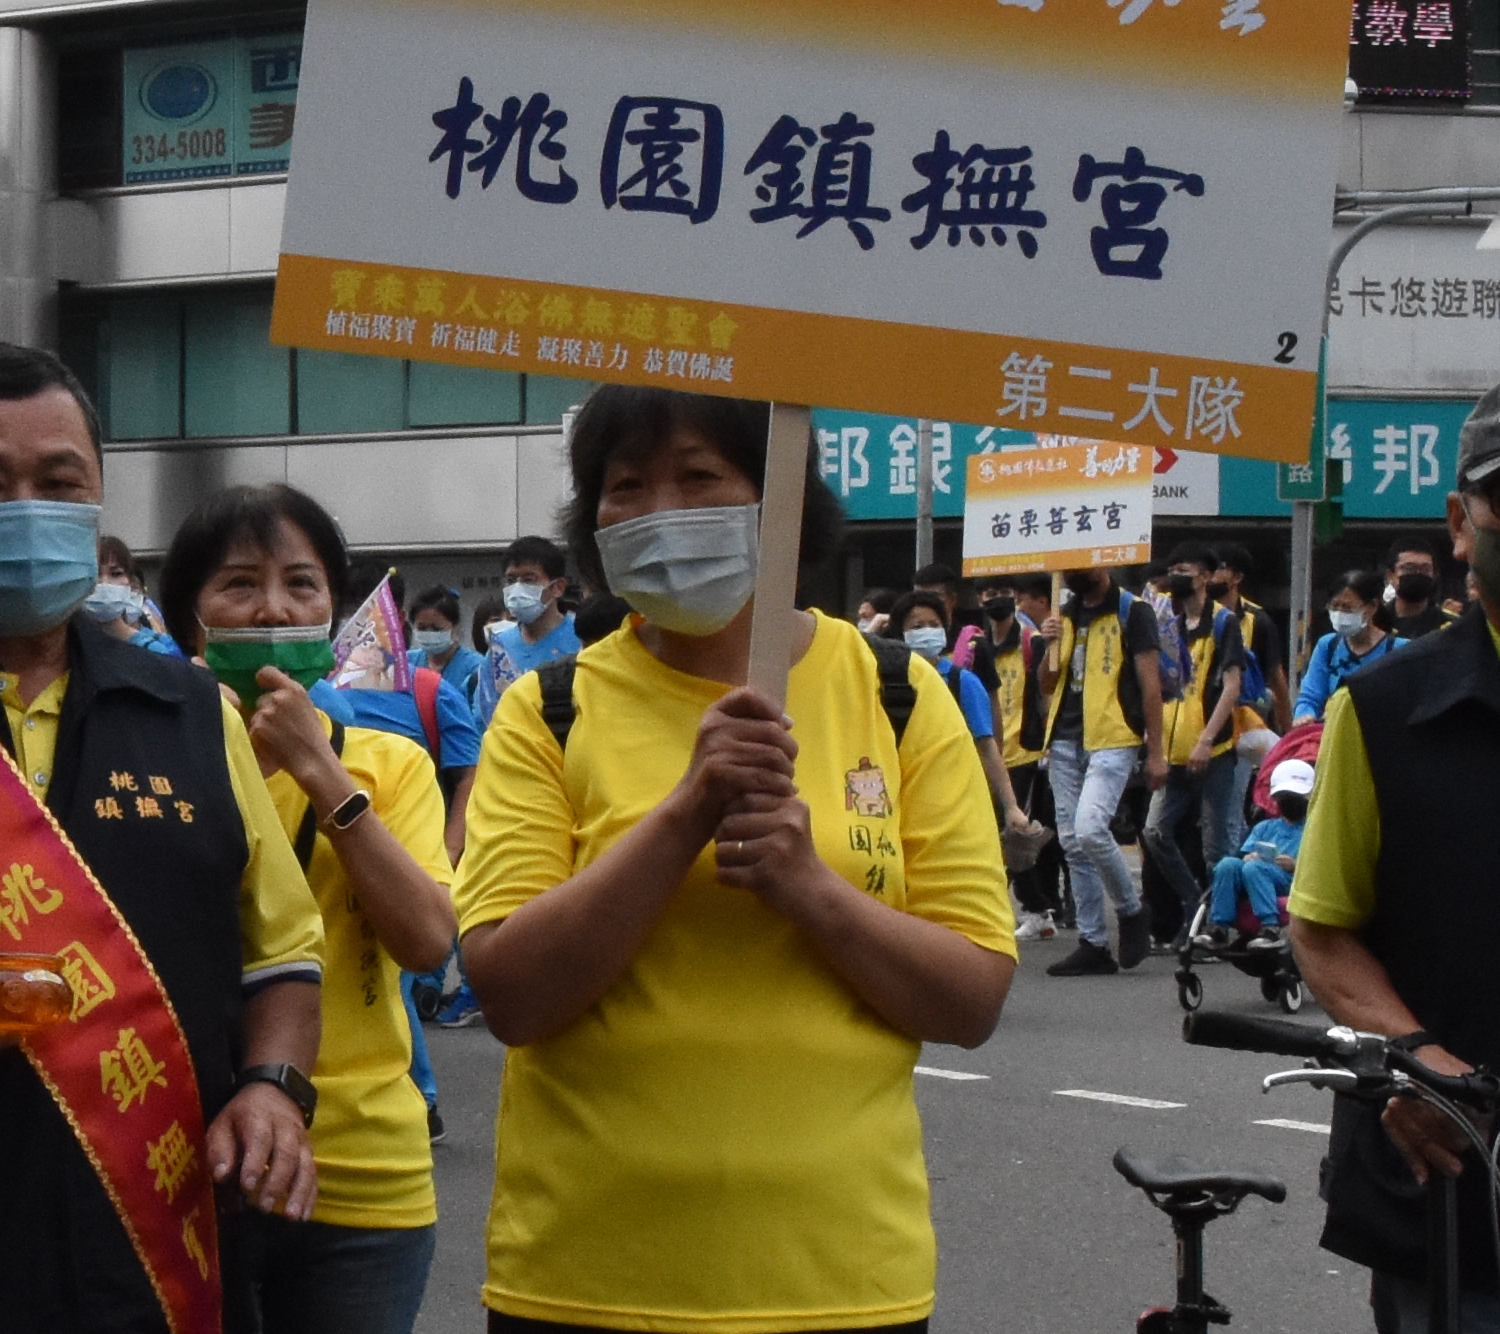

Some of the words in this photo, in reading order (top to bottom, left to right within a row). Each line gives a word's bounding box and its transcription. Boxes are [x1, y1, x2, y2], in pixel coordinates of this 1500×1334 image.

[428, 76, 1205, 282] 桃園鎮撫宮
[325, 308, 418, 346] 植福聚寶
[430, 321, 521, 358] 祈福健走
[537, 335, 630, 371] 凝聚善力
[643, 347, 735, 383] 恭賀佛誕
[1274, 331, 1299, 366] 2
[997, 350, 1246, 445] 第二大隊
[94, 795, 195, 823] 鎮撫宮
[108, 770, 174, 796] 桃園
